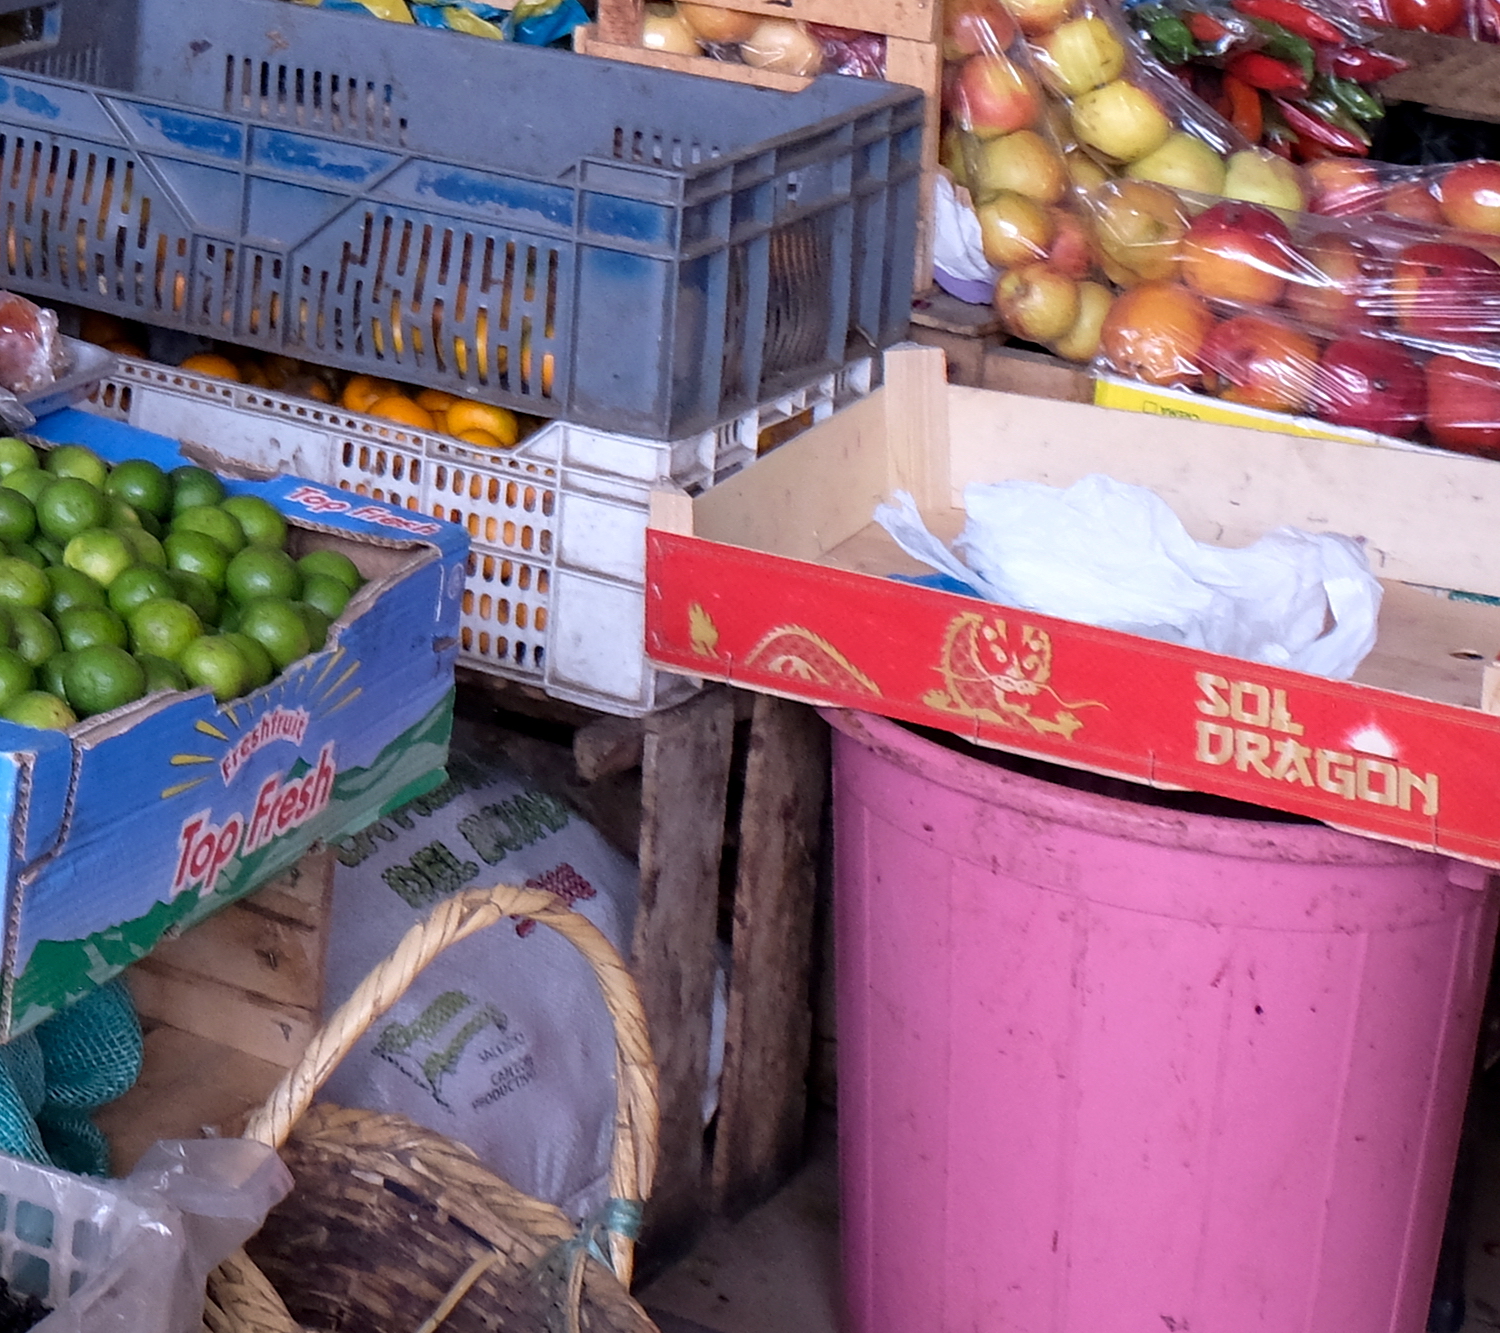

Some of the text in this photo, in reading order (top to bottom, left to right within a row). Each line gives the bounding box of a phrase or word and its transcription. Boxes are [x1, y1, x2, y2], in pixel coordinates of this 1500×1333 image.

[290, 487, 441, 535] Top Fresh
[1194, 672, 1304, 736] SOL
[221, 709, 307, 781] Freshfruit
[1196, 721, 1439, 816] DRAGON
[175, 819, 239, 889] Top
[247, 748, 332, 848] Fresh
